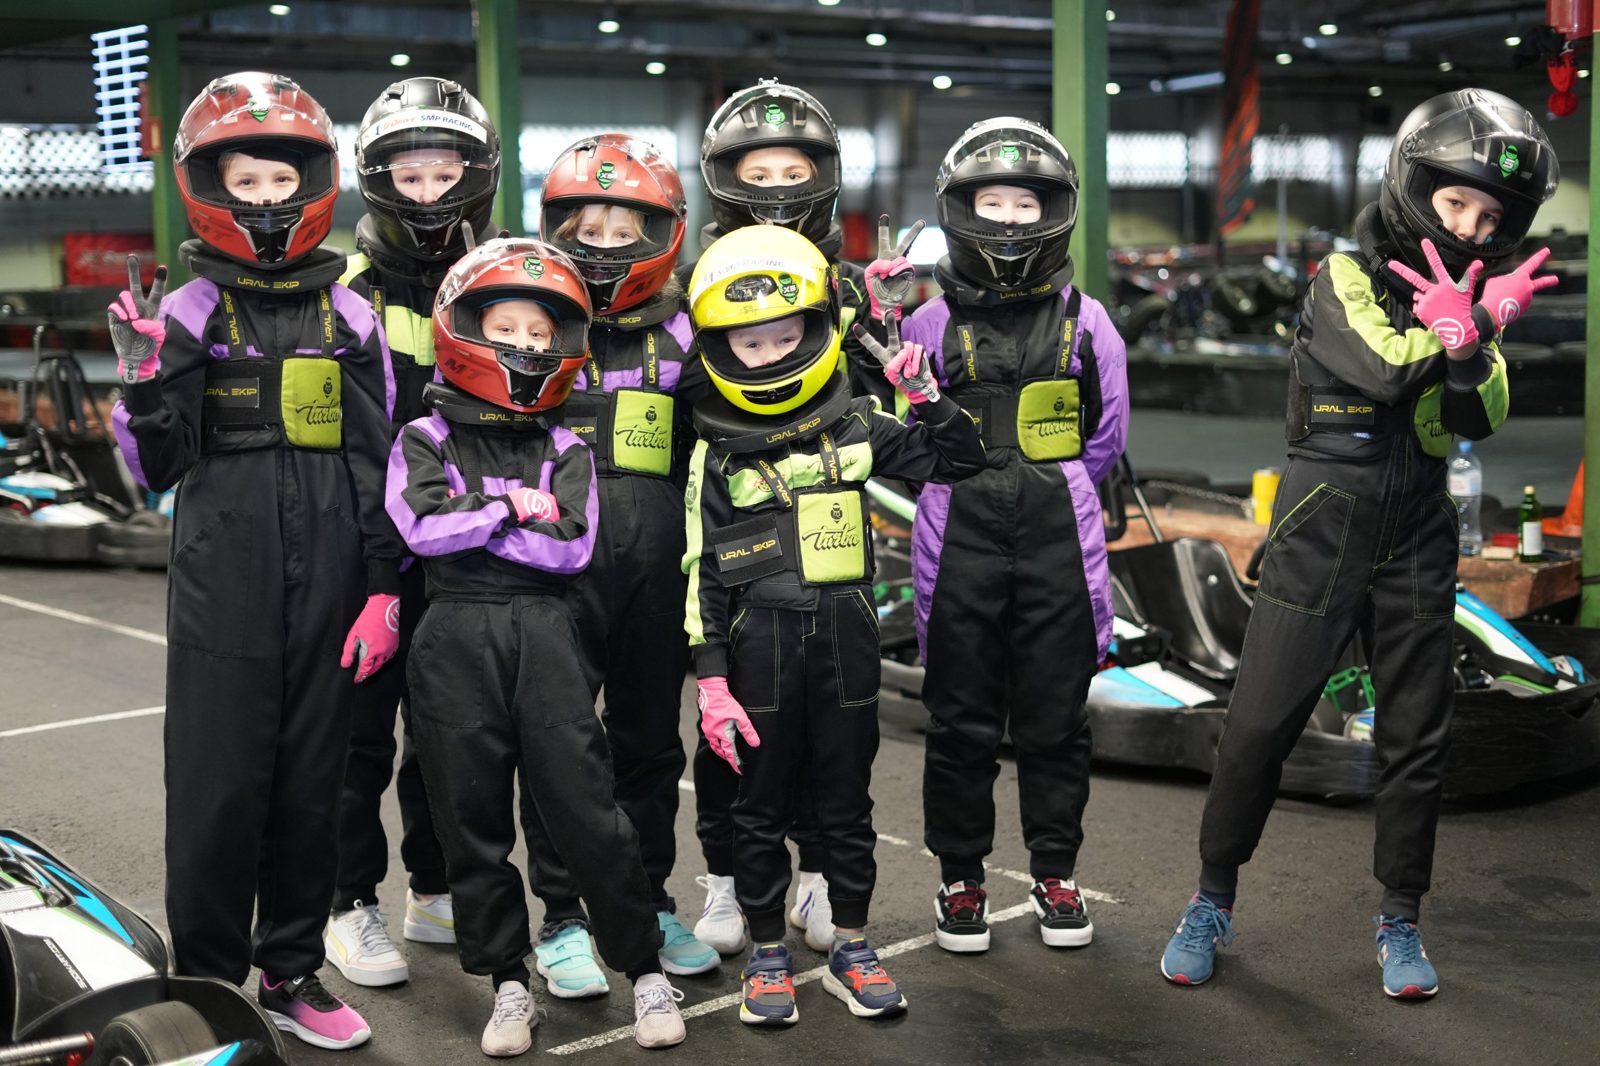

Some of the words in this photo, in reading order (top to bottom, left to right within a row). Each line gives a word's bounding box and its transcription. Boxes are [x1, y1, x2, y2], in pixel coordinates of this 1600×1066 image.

[421, 114, 441, 122] SMP
[442, 116, 473, 132] RACING
[237, 277, 269, 288] URAL
[273, 281, 300, 289] EKIP
[783, 284, 797, 294] XS
[320, 289, 330, 311] EKIP
[227, 316, 240, 345] URAL
[323, 313, 333, 343] URAL
[617, 316, 641, 324] EKIP
[1064, 320, 1073, 342] EKIP
[963, 329, 972, 351] EKIP
[968, 353, 976, 381] URAL
[1060, 345, 1070, 373] URAL
[590, 359, 600, 386] URAL
[231, 388, 257, 396] EKIP
[480, 412, 510, 421] URAL
[1314, 405, 1344, 413] URAL
[571, 426, 595, 434] EKIP
[766, 430, 796, 443] URAL
[798, 417, 821, 432] EKIP
[758, 460, 776, 479] EKIP
[828, 455, 838, 485] URAL
[776, 481, 792, 508] URAL
[720, 548, 751, 561] URAL
[752, 539, 777, 552] EKIP
